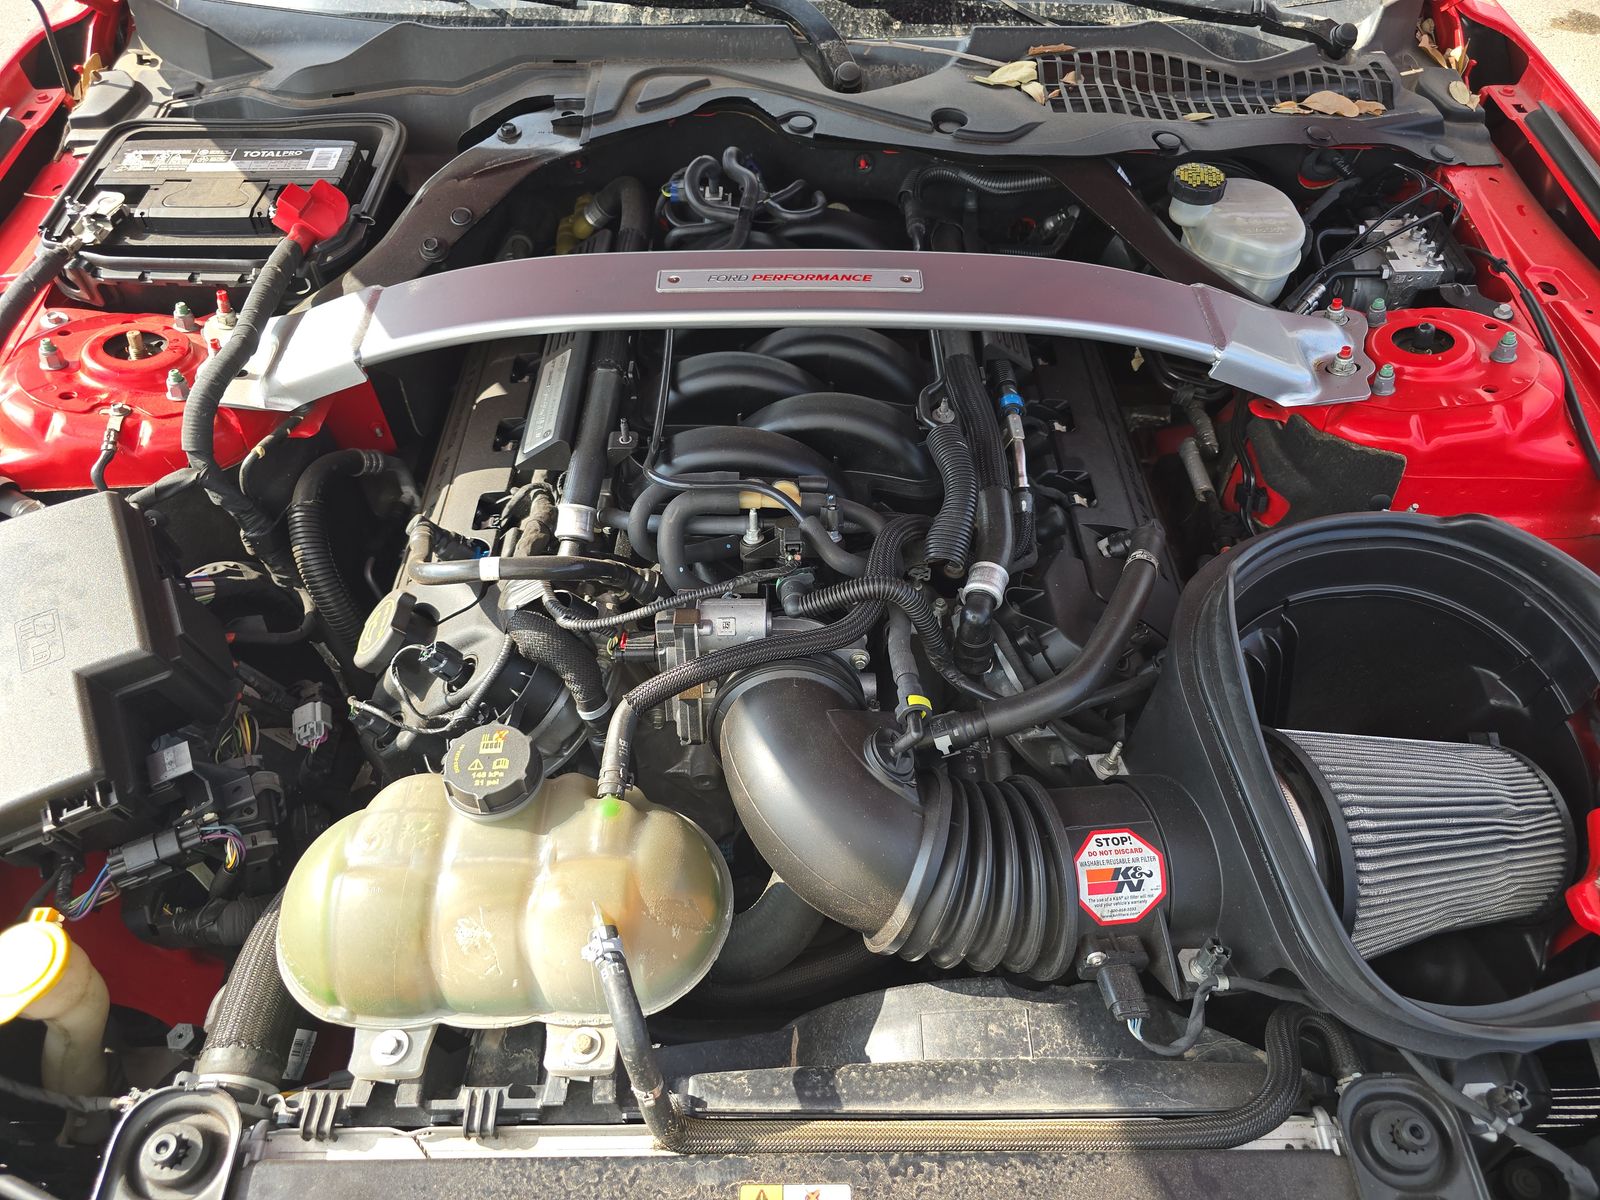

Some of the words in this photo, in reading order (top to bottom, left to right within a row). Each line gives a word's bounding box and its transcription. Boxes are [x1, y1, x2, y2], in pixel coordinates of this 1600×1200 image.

[707, 274, 749, 282] FORD
[751, 273, 873, 282] PERFORMANCE
[1095, 836, 1133, 847] STOP!
[1099, 849, 1113, 857] NOT
[1114, 847, 1143, 855] DISCARD
[1140, 855, 1157, 863] FILTER
